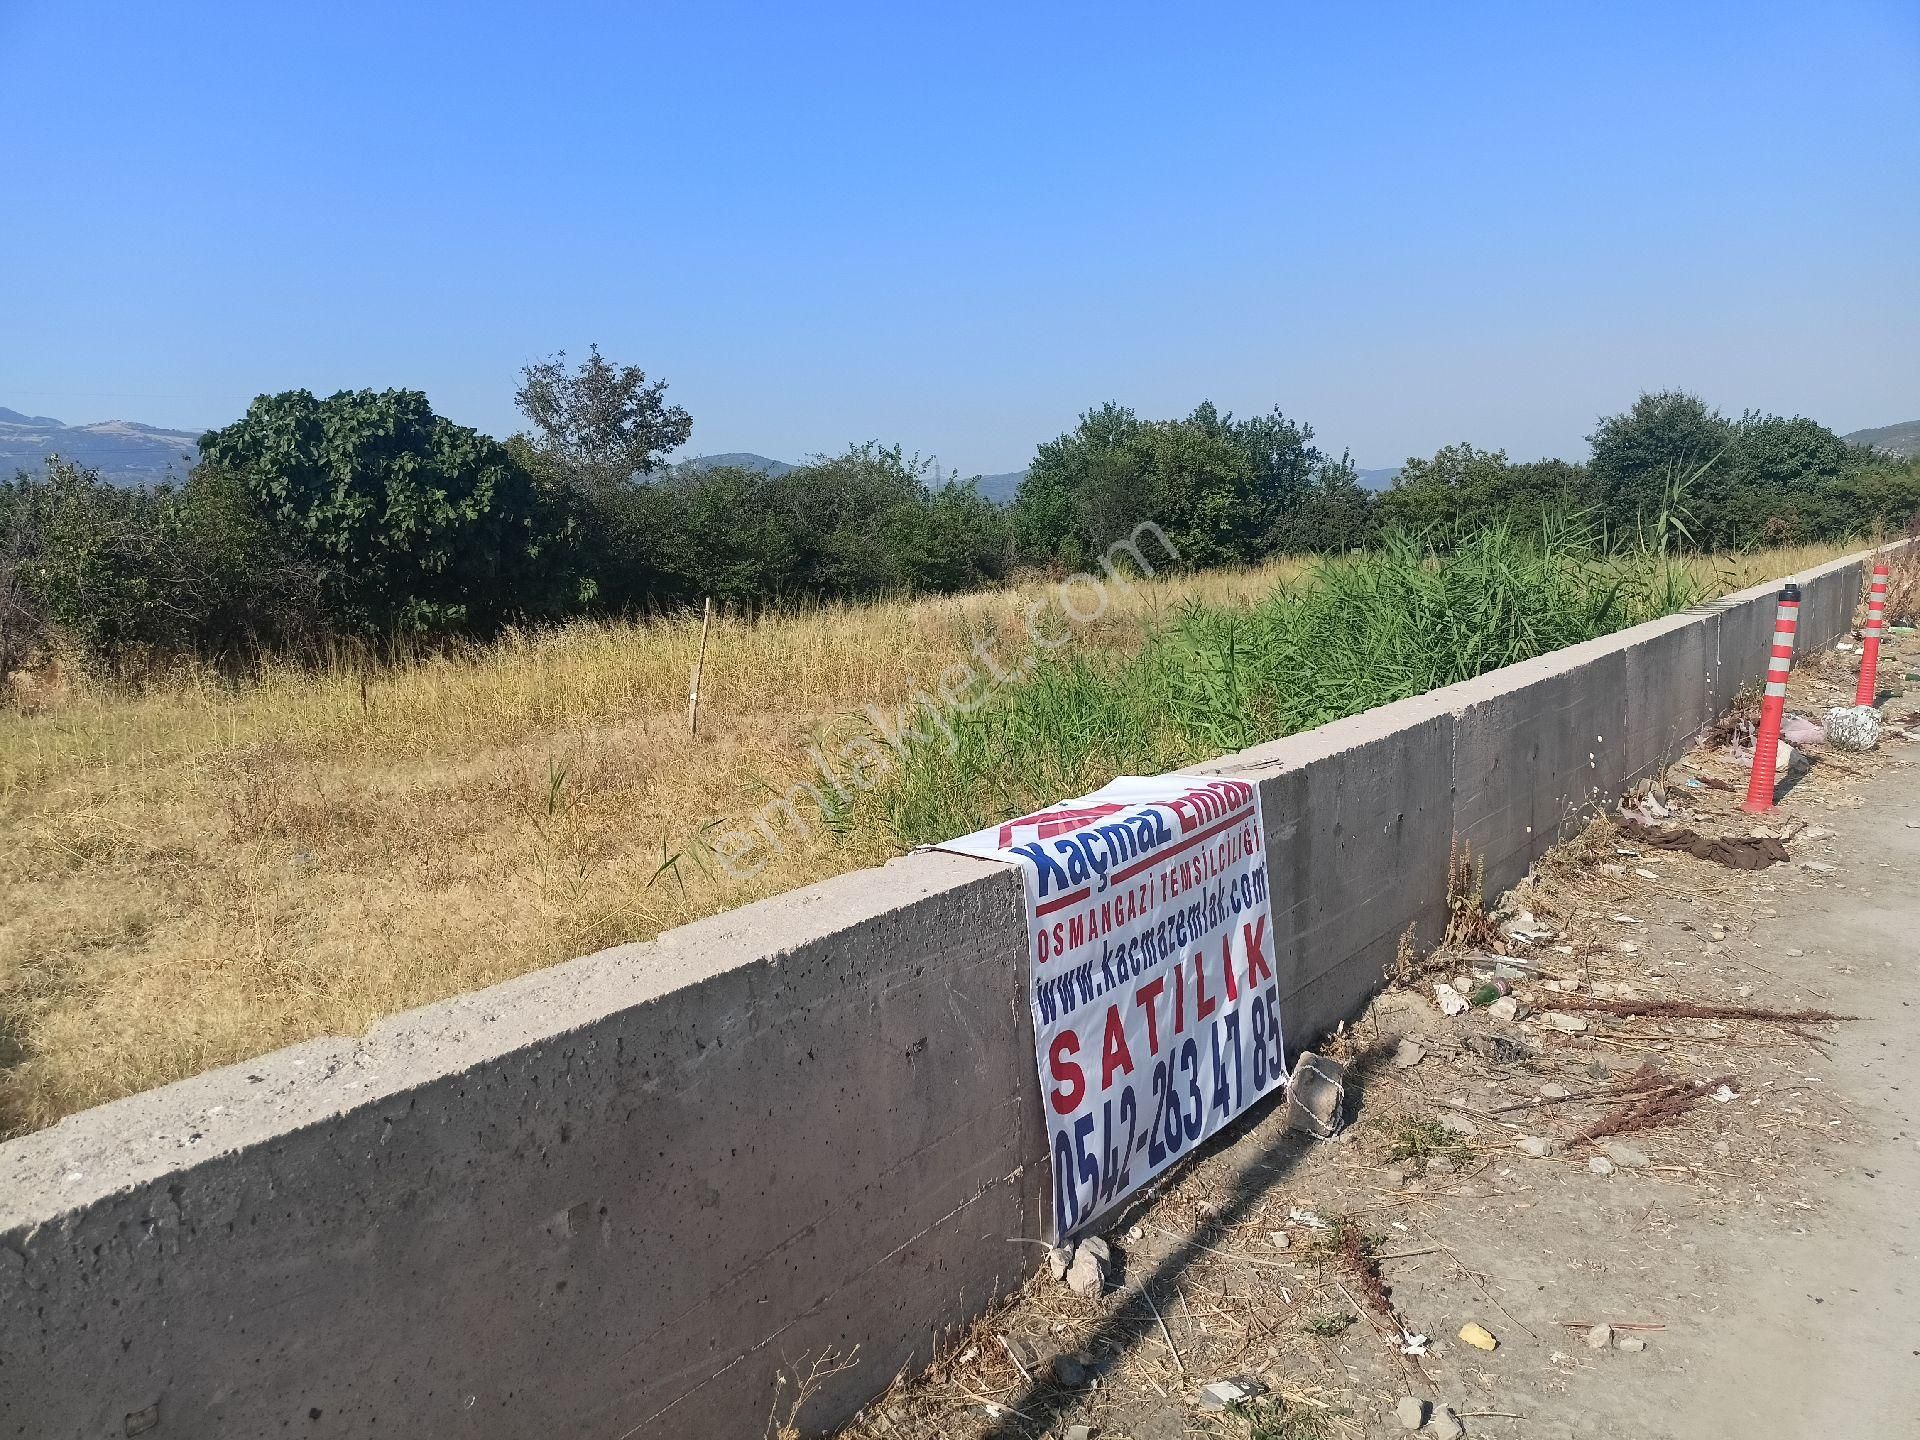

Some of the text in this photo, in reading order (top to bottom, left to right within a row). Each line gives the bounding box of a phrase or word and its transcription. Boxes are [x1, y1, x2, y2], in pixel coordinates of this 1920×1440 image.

[1009, 809, 1172, 898] Kaçmaz
[1036, 866, 1268, 1026] www.kacmazemlak.com
[1037, 873, 1154, 964] OSMANGAZİ
[1049, 914, 1272, 1115] SATILIK
